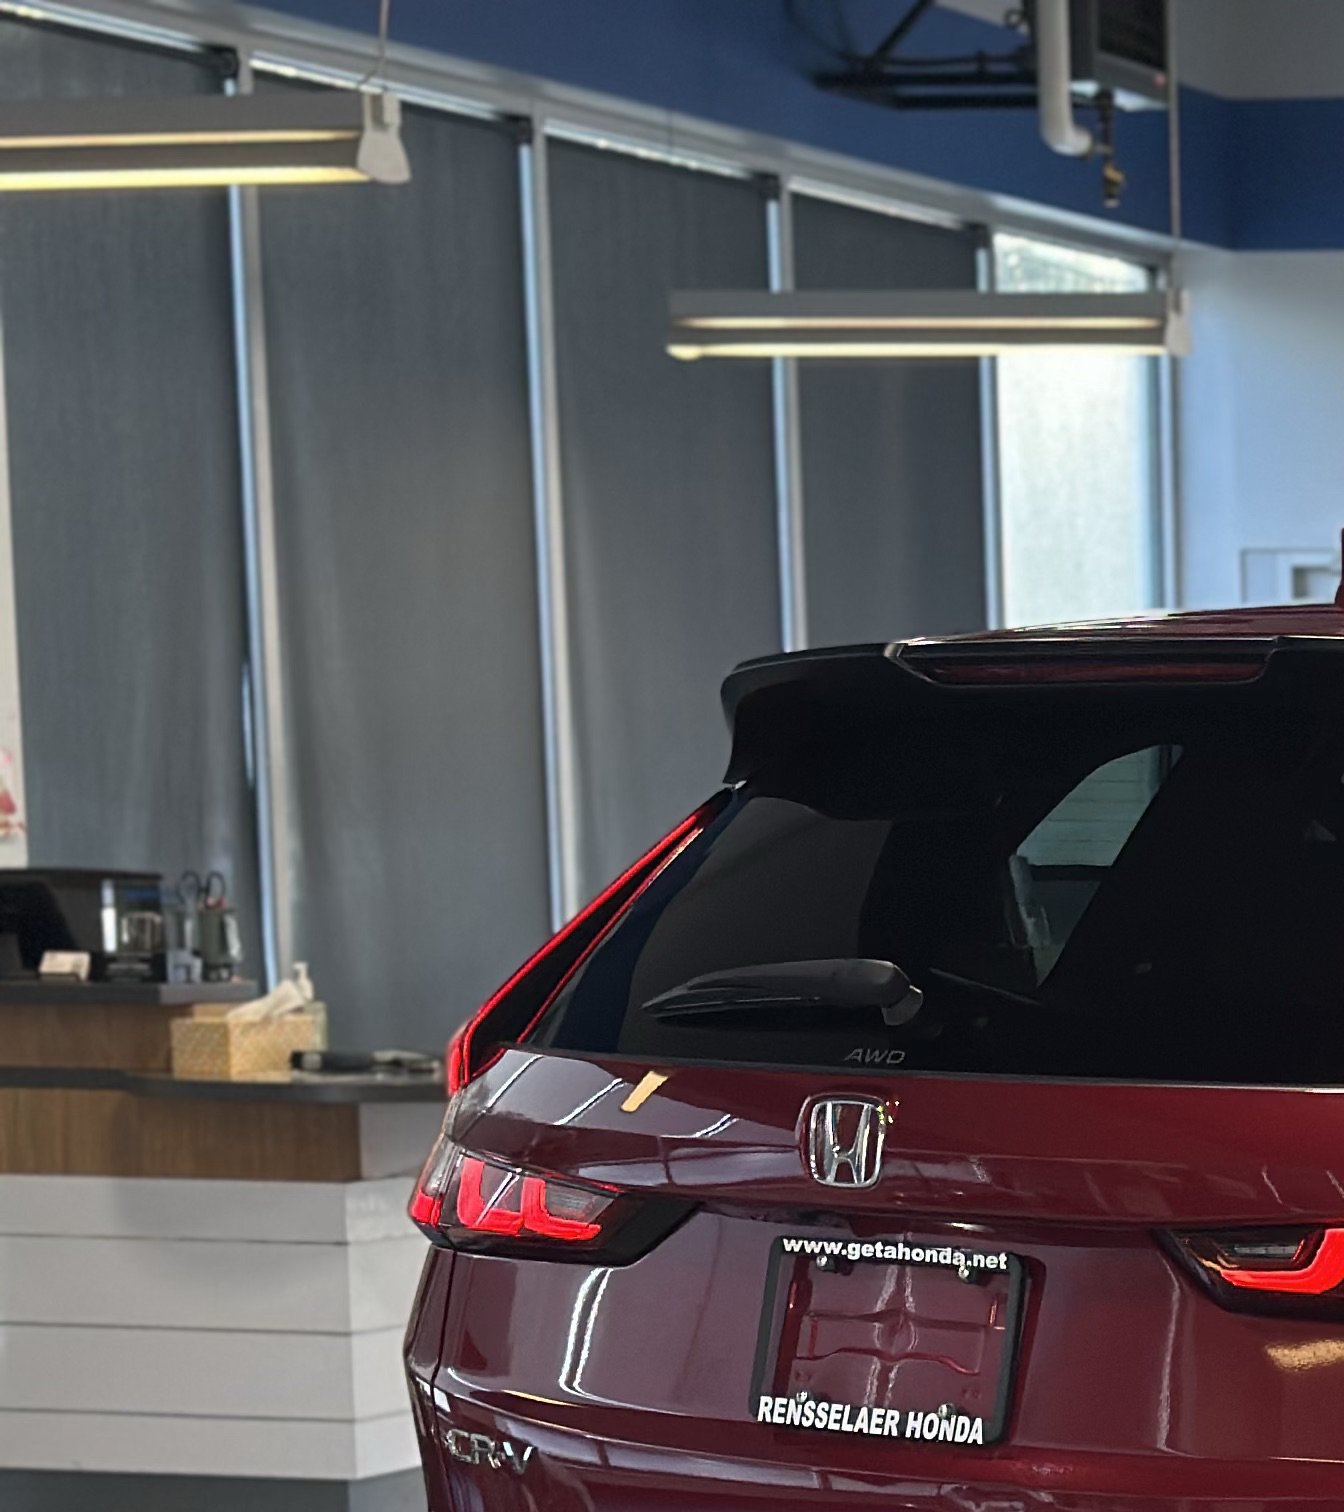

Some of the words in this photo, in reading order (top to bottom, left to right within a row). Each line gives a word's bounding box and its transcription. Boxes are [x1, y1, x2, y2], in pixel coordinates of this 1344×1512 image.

[844, 1048, 906, 1064] AWD
[783, 1237, 1007, 1269] www.getahonda.net
[757, 1395, 900, 1436] RENSSELAER
[905, 1411, 983, 1445] HONDA
[446, 1428, 534, 1475] CR-V
